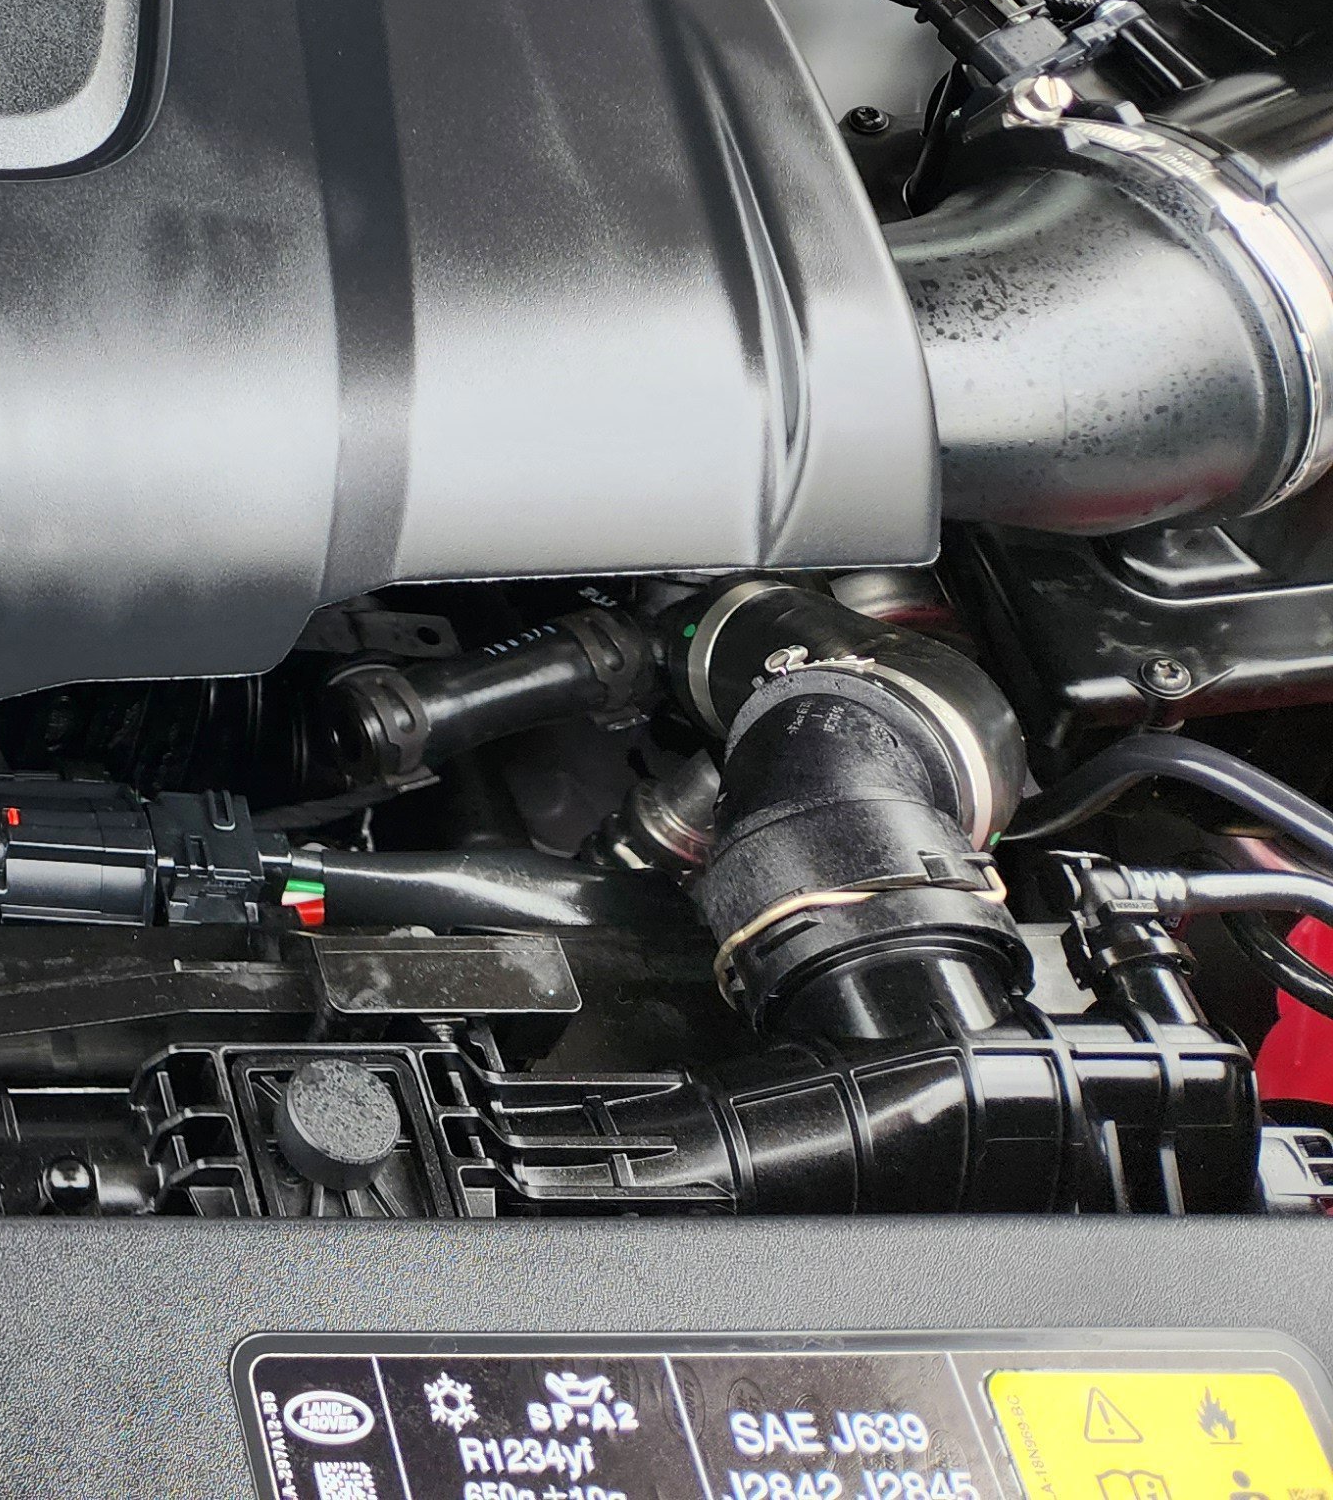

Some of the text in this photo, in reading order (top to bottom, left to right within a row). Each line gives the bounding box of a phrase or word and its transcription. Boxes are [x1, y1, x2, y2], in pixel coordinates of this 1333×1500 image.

[302, 1401, 343, 1415] LAND
[306, 1414, 360, 1432] ROVER
[260, 1391, 299, 1500] A-297A12-BB
[730, 1410, 929, 1455] SAE J639
[1006, 1394, 1058, 1500] A-18N969-BC
[459, 1437, 595, 1482] R1234yf
[722, 1470, 981, 1500] J2842 J2845
